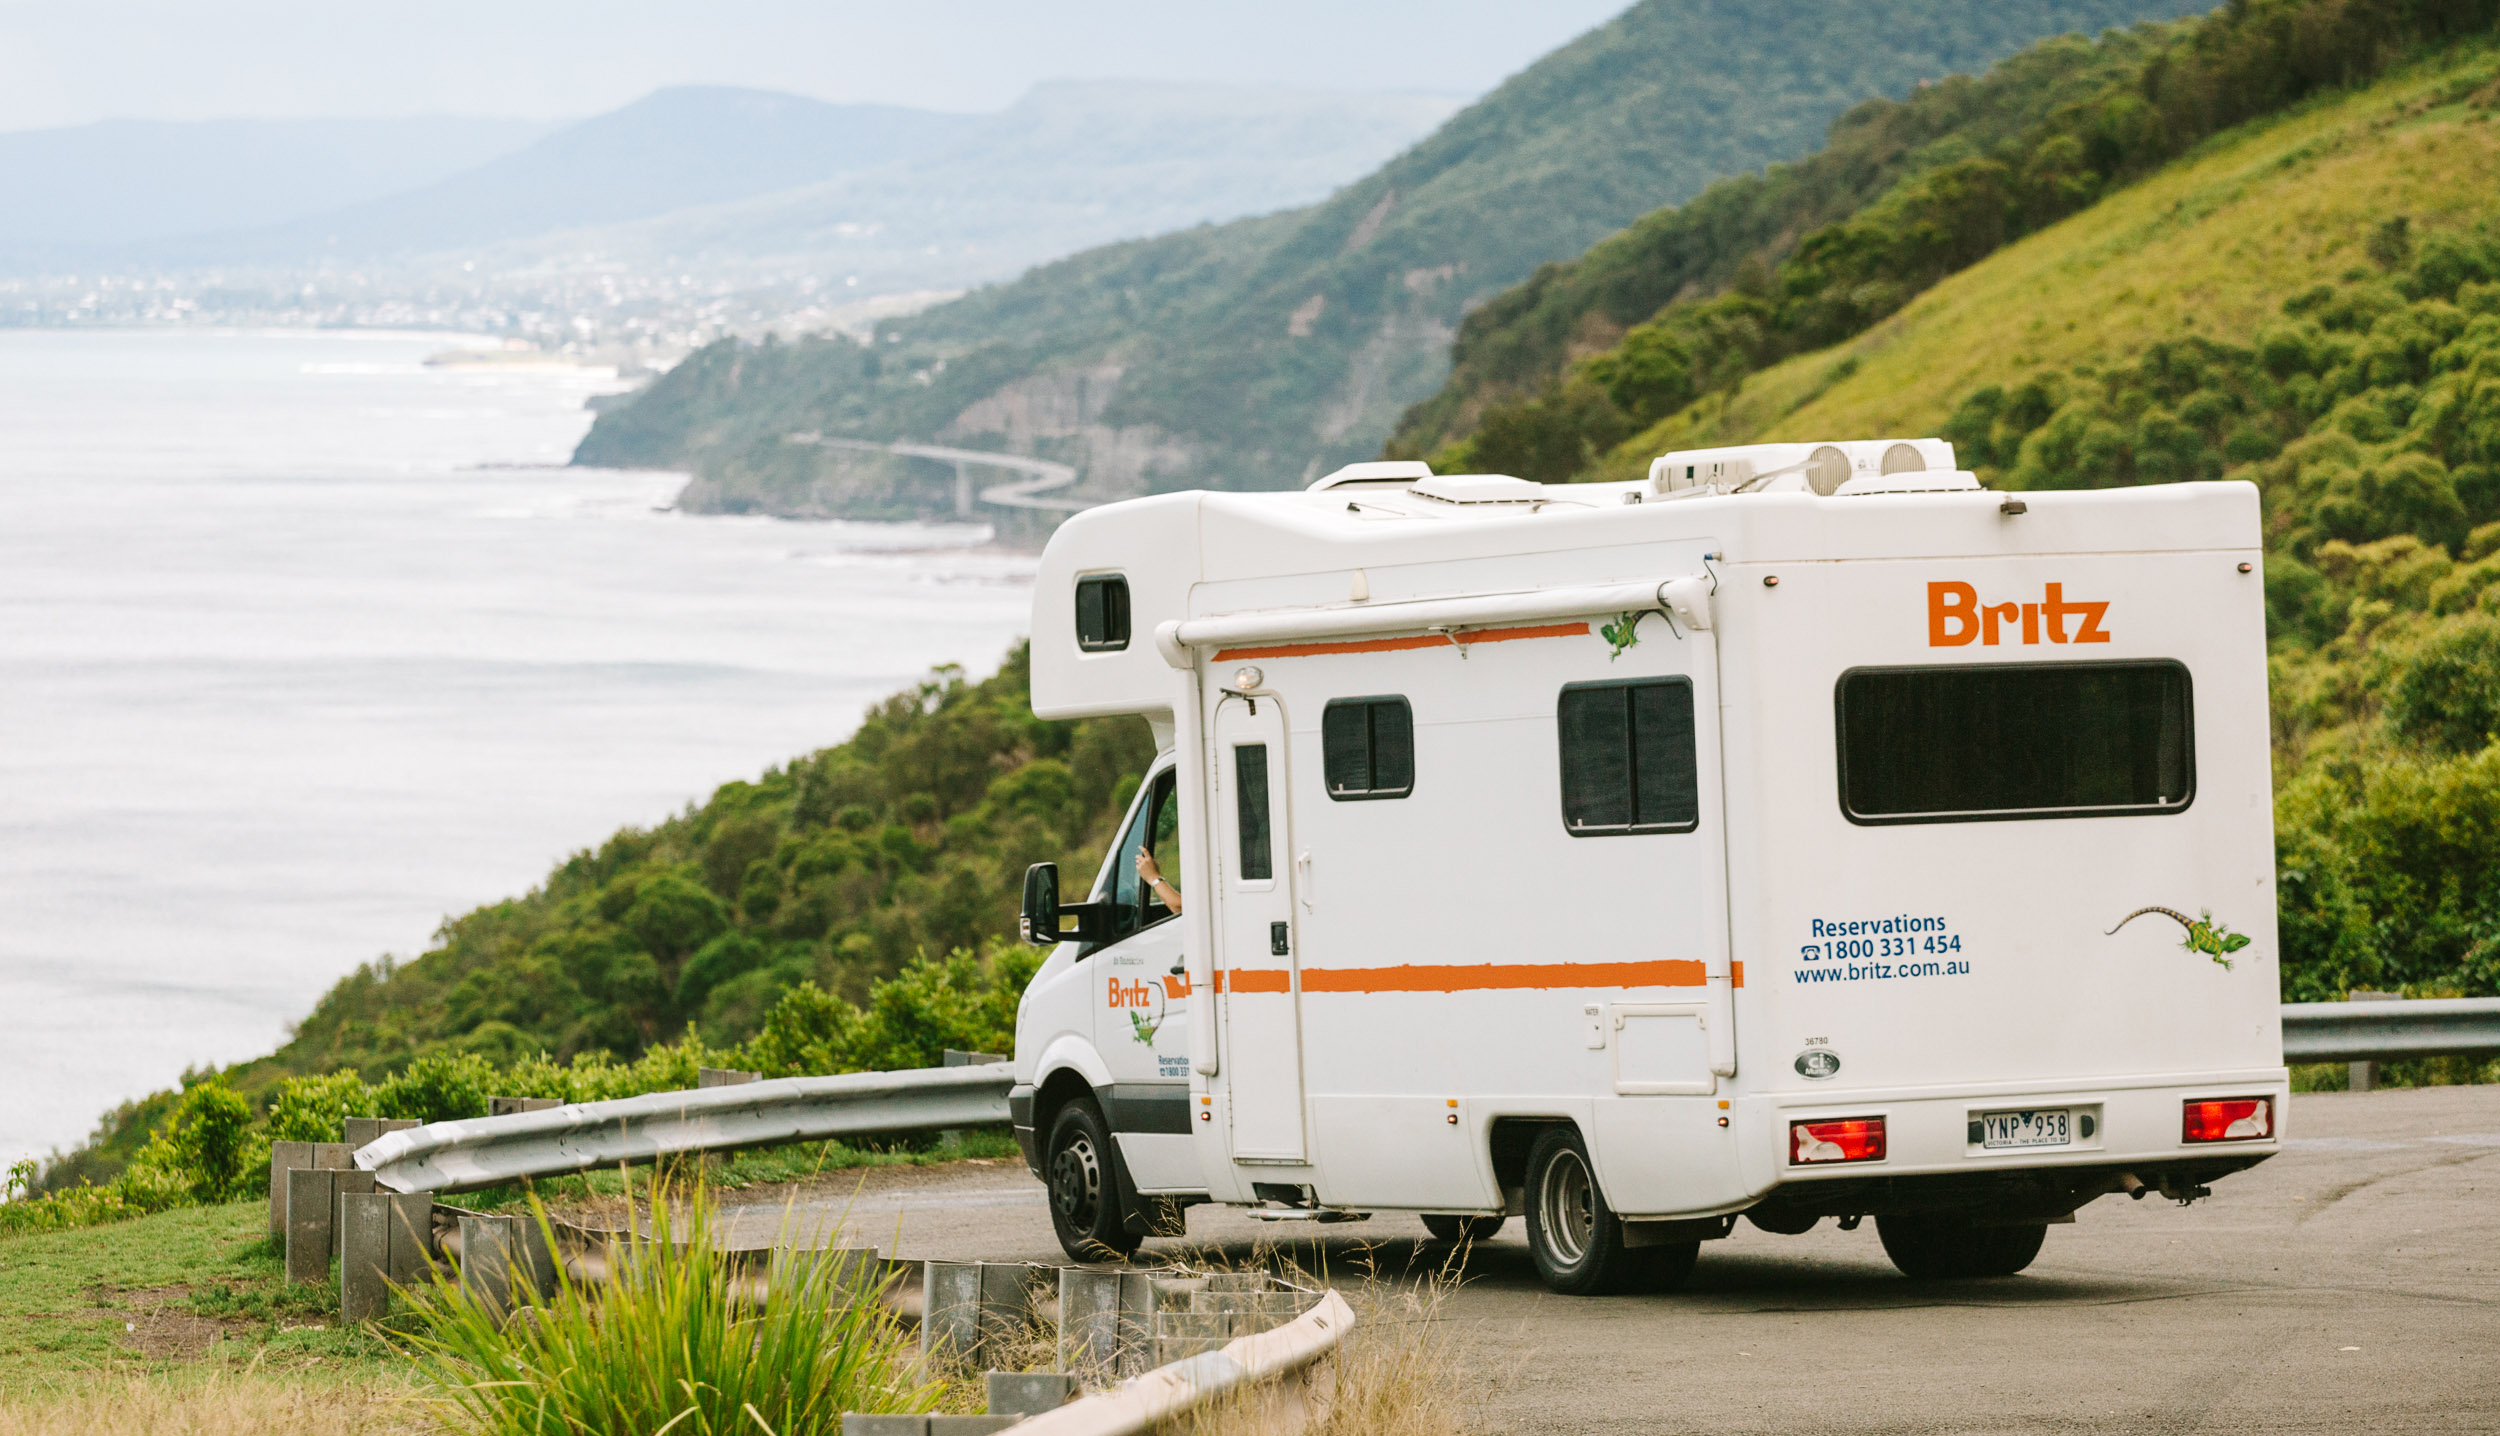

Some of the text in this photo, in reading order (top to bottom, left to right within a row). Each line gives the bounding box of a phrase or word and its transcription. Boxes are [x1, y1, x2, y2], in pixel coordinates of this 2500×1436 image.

[1927, 581, 2110, 647] Britz
[1811, 914, 1946, 937] Reservations
[1824, 935, 1962, 960] 1800 331 454
[1794, 961, 1970, 983] www.britz.com.au
[1108, 977, 1150, 1008] Britz
[1166, 1066, 1179, 1076] 1800
[1986, 1115, 2066, 1139] YNP 958
